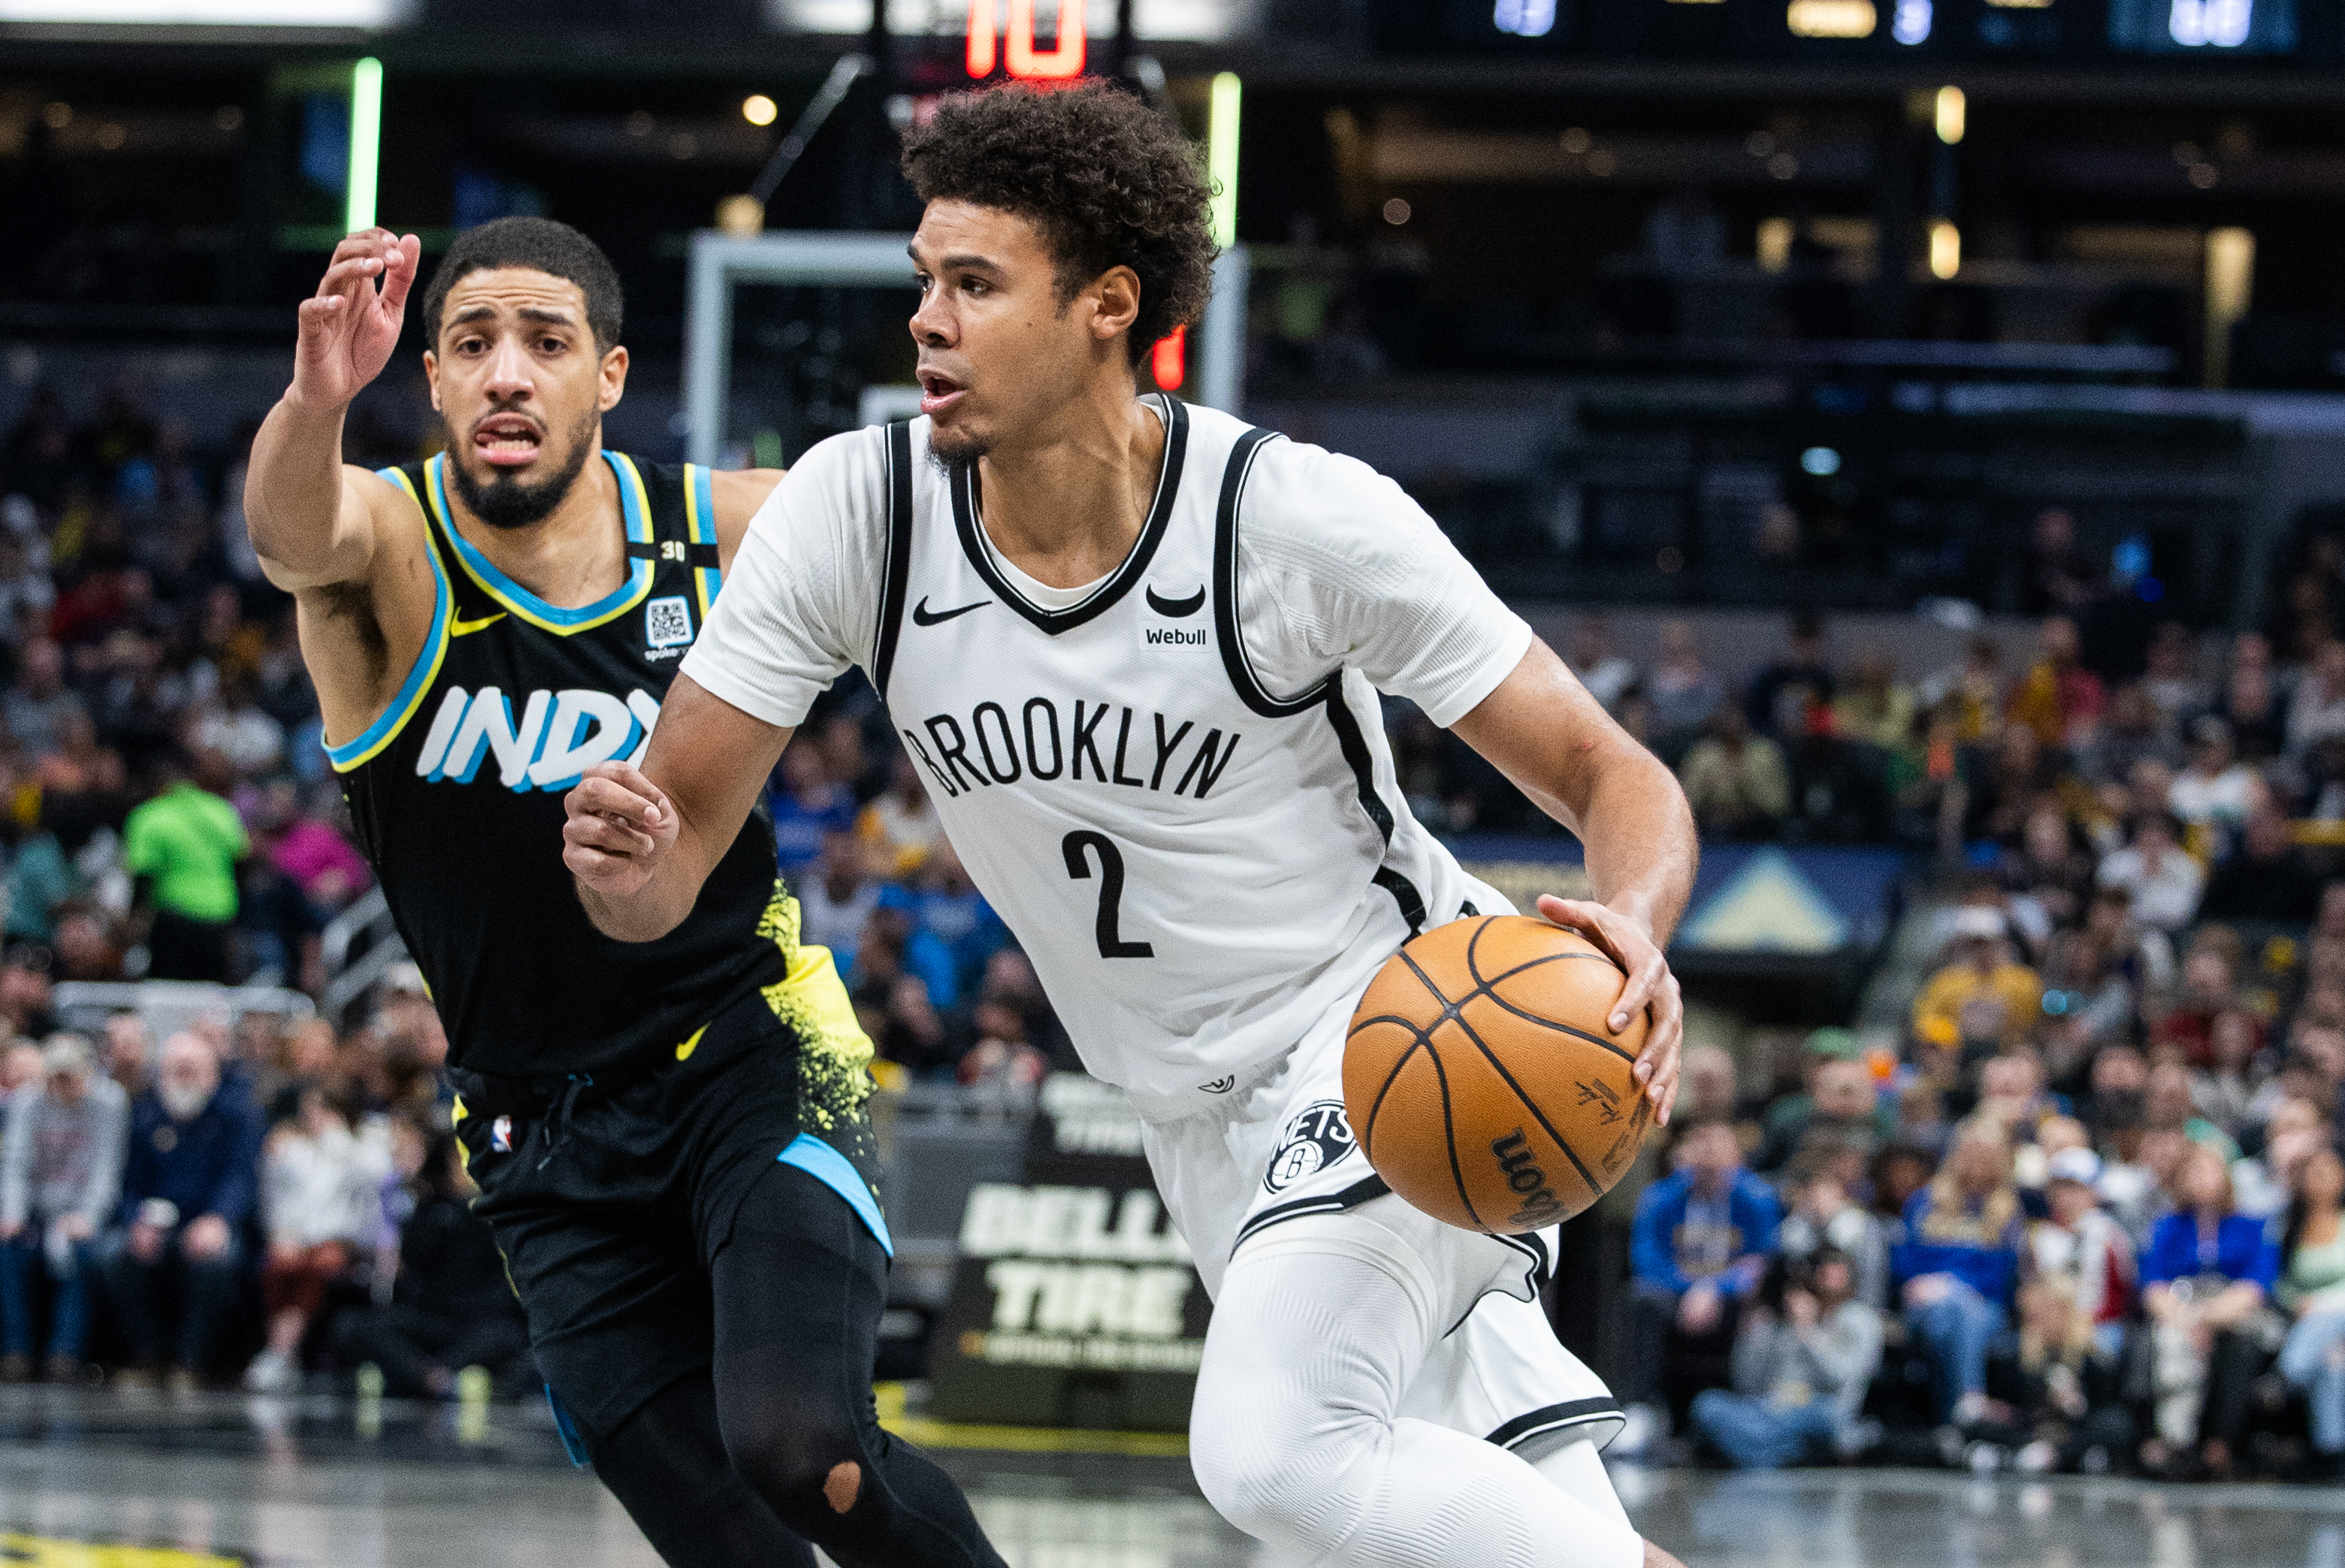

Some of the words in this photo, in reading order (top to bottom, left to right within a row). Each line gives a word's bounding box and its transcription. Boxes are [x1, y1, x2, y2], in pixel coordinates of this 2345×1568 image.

[660, 540, 685, 562] 30
[1146, 628, 1207, 645] Webull
[903, 696, 1241, 799] BROOKLYN
[1062, 829, 1155, 959] 2
[1271, 1105, 1355, 1162] NETS
